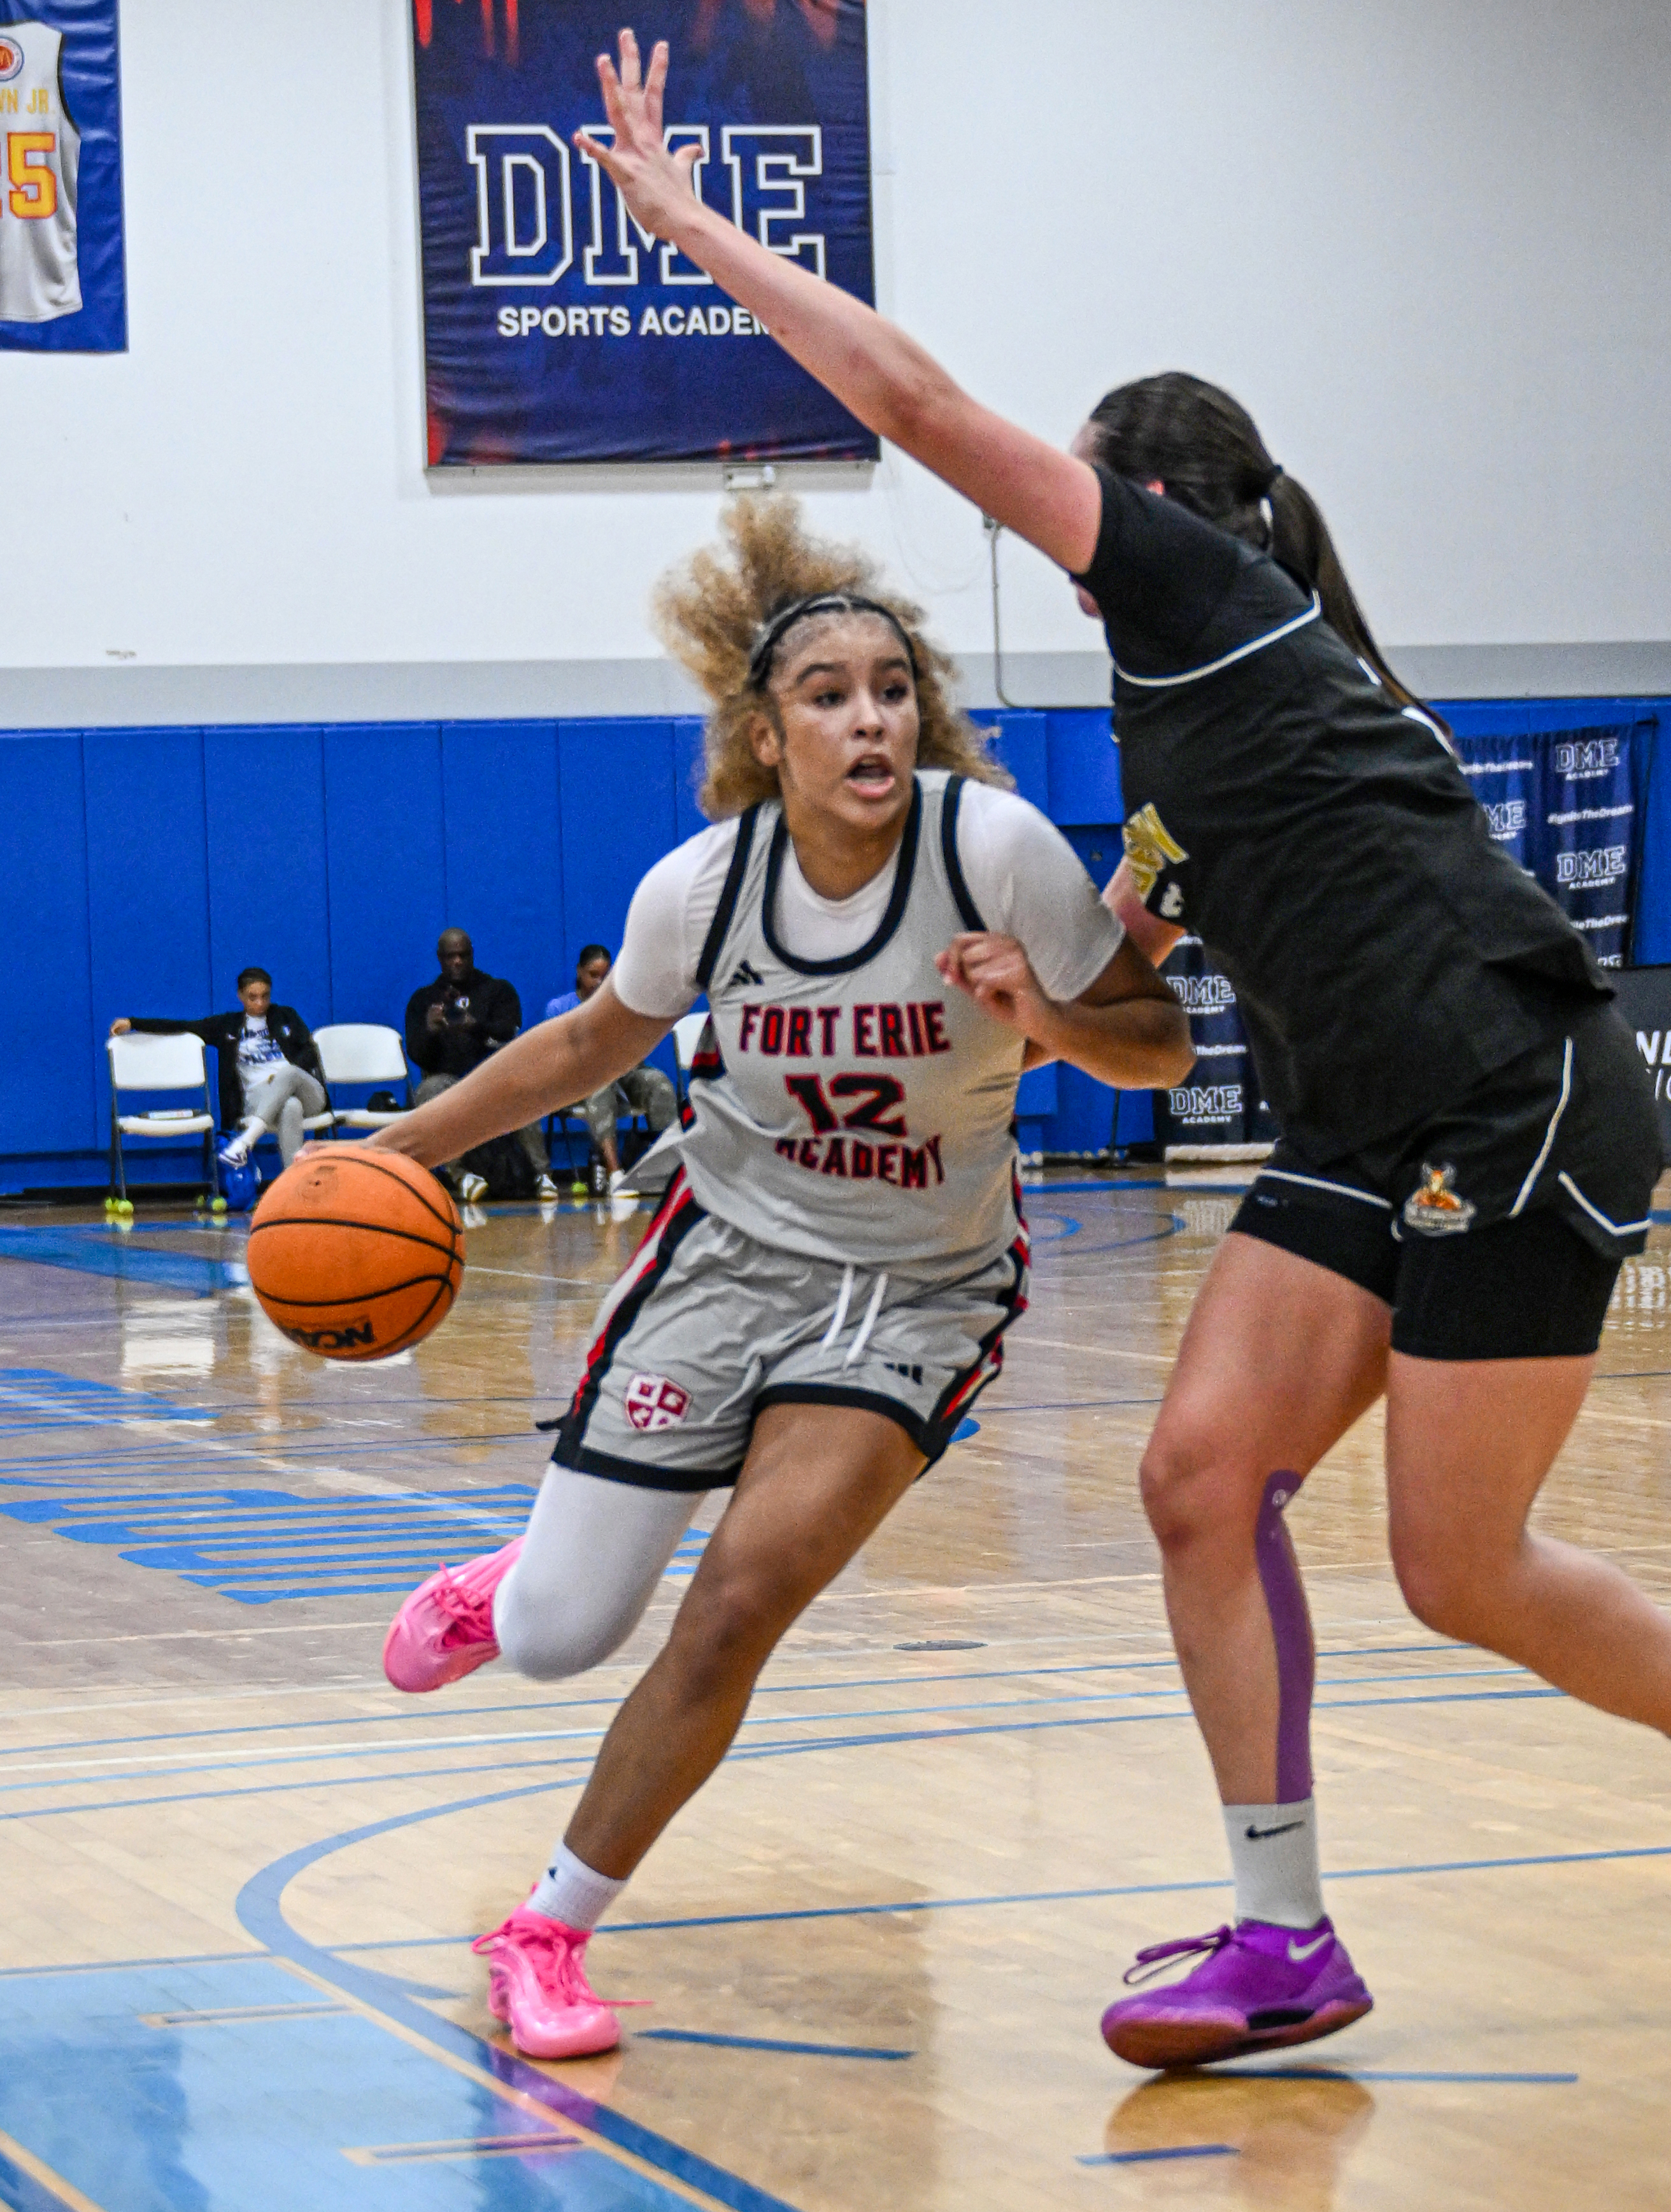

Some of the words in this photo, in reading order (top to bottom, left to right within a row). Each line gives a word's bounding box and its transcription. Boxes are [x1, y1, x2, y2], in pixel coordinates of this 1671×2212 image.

[0, 132, 57, 219] 5
[466, 124, 826, 286] DME
[498, 306, 630, 336] SPORTS
[1556, 738, 1621, 773] DME
[1483, 800, 1526, 832] ME
[1556, 846, 1626, 883] DME
[739, 1003, 841, 1057] FORT
[853, 1000, 951, 1058] ERIE
[785, 1072, 907, 1137] 12
[1169, 1085, 1243, 1115] DME
[1182, 1116, 1232, 1124] ACADEMY
